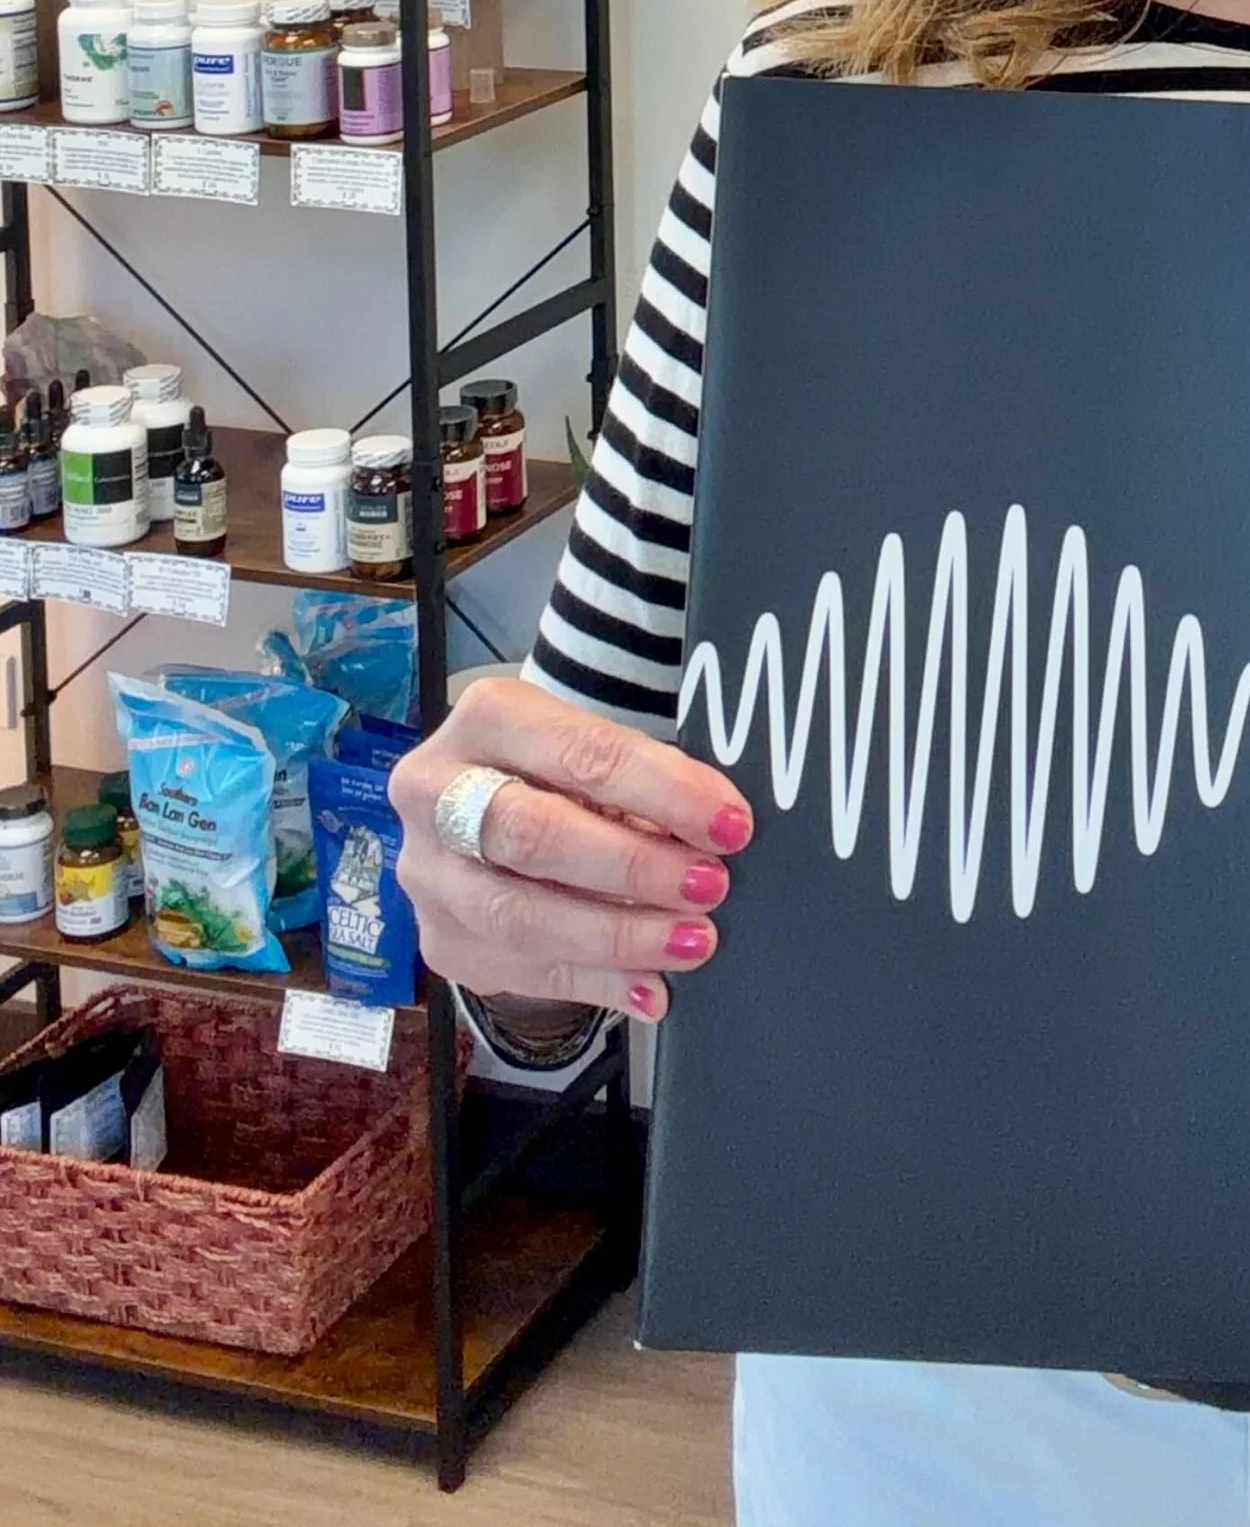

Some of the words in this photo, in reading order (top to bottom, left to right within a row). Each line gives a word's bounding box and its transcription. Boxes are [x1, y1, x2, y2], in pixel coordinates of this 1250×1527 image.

[284, 494, 322, 505] pure
[138, 791, 160, 815] Ban
[162, 801, 185, 823] Lan
[187, 811, 217, 832] Gen
[330, 907, 381, 938] CELTIC
